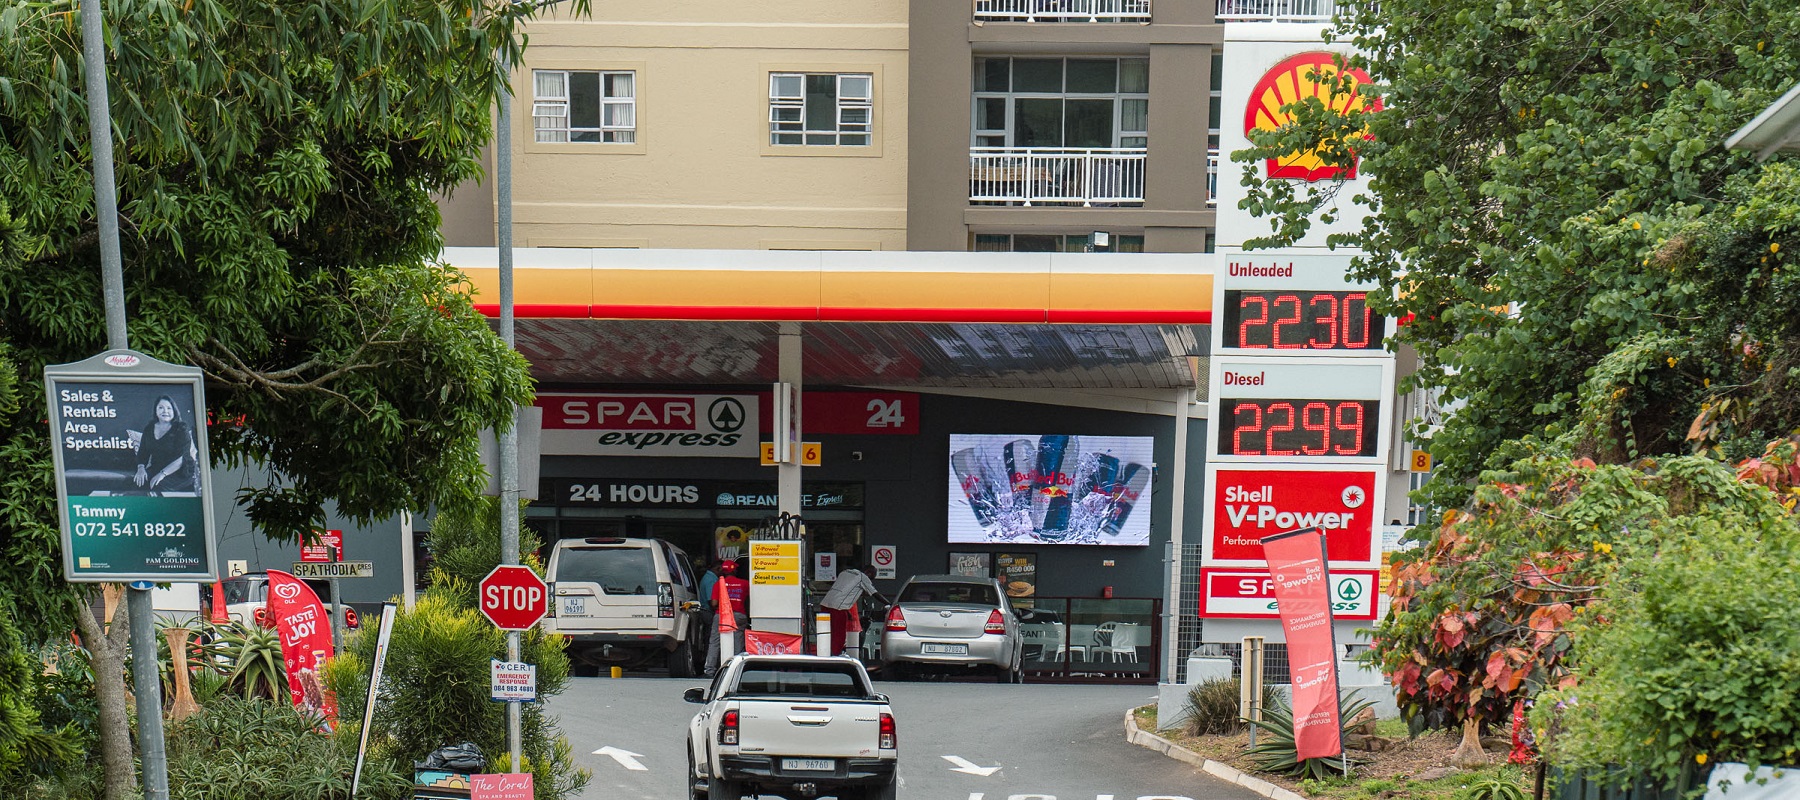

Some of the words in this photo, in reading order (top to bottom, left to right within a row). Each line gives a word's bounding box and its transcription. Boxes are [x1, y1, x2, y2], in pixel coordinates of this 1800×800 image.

[1229, 262, 1293, 277] Unleaded
[1239, 293, 1371, 350] 22.30
[1224, 371, 1265, 386] Diesel
[61, 389, 99, 402] Sales
[102, 390, 114, 402] &
[63, 405, 117, 418] Rentals
[562, 401, 692, 425] SPAR
[866, 398, 905, 427] 24
[64, 421, 97, 433] Area
[1233, 402, 1364, 455] 22.99
[65, 436, 134, 451] Specialist
[598, 431, 743, 449] express
[806, 447, 817, 461] 6
[1416, 455, 1426, 467] 8
[569, 484, 602, 502] 24
[610, 484, 699, 503] HOURS
[1225, 485, 1273, 503] Shell
[72, 504, 126, 520] Tammy
[1225, 504, 1355, 529] V-Power
[75, 523, 107, 537] 072
[111, 523, 139, 537] 541
[144, 523, 186, 537] 8822
[717, 546, 740, 559] WIN
[295, 564, 357, 576] SPATHODIA
[486, 584, 541, 612] STOP
[284, 610, 314, 626] TASTE
[290, 620, 316, 641] JOY
[788, 760, 798, 768] NJ
[805, 760, 829, 769] 96760
[473, 777, 495, 793] The
[498, 776, 529, 792] Coral
